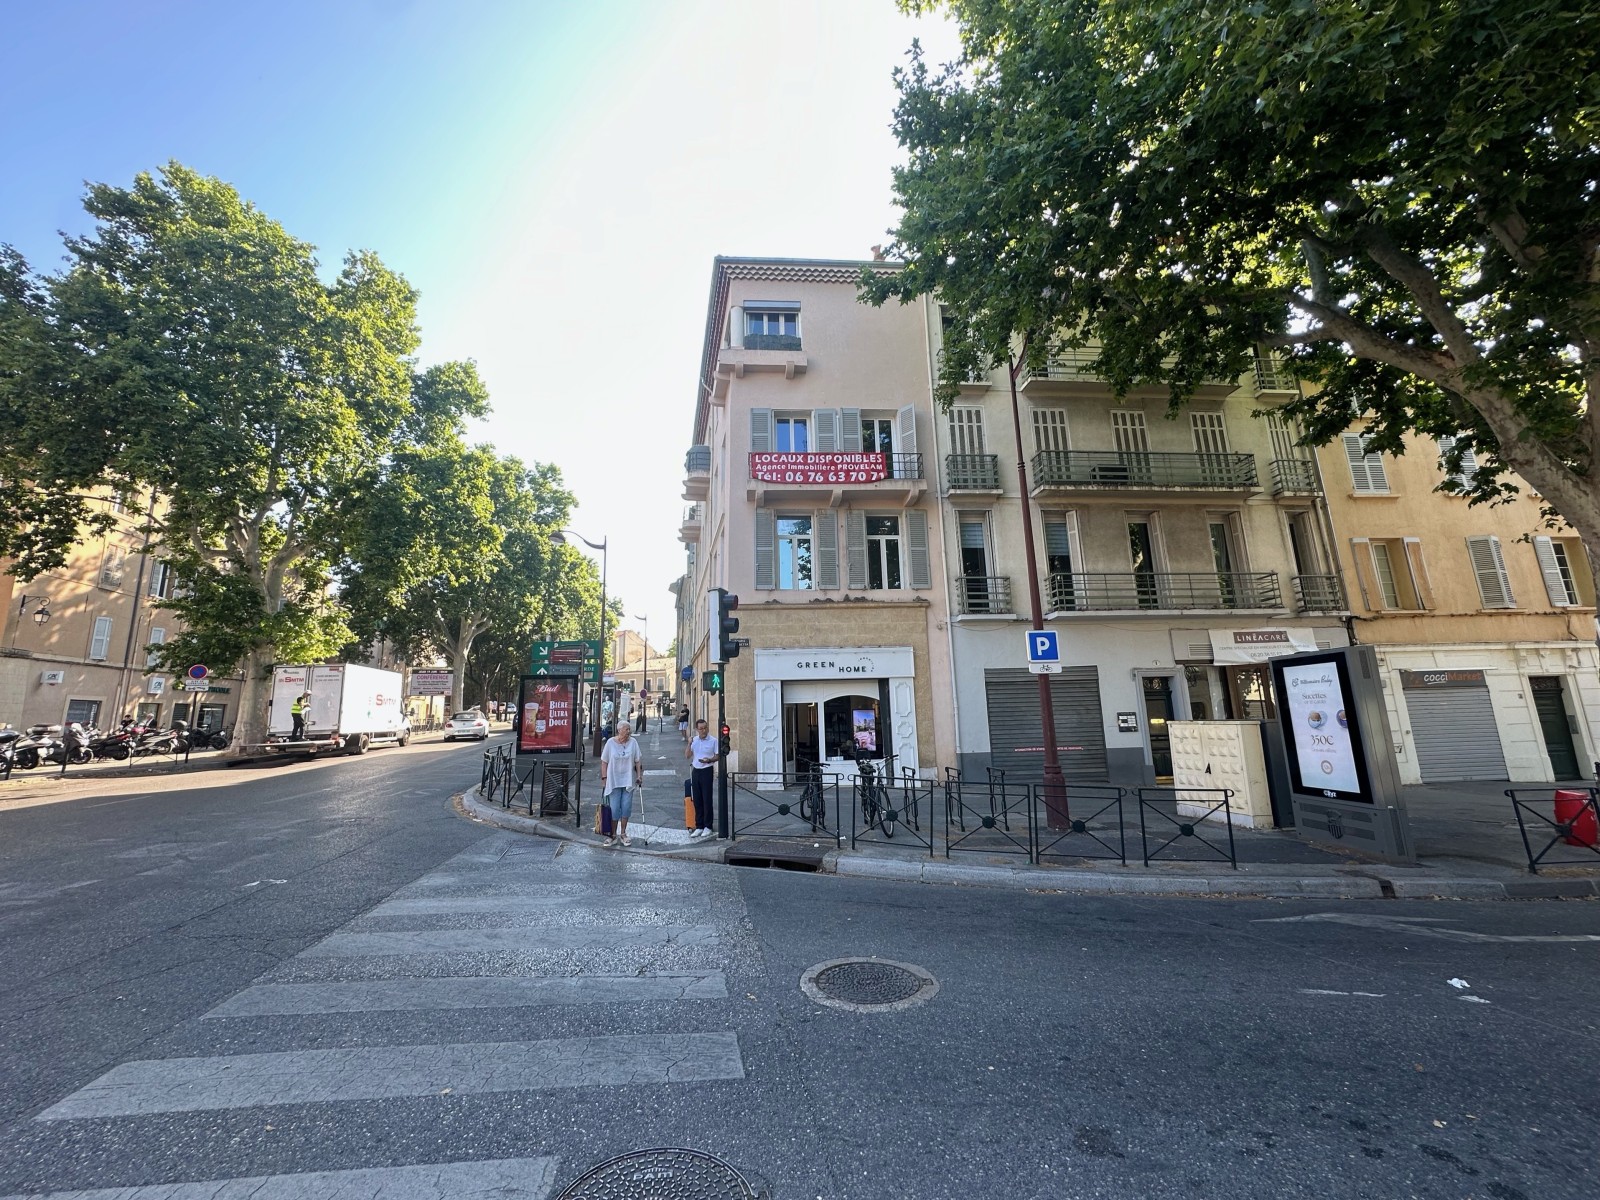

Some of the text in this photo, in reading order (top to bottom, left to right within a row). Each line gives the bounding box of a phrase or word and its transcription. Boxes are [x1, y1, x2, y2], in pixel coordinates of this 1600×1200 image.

[755, 454, 882, 463] LOCAUX DISPONIBLES
[755, 463, 786, 472] Agence
[756, 471, 885, 482] Tél: 06 76 63 70 71
[1036, 637, 1050, 656] P
[797, 661, 835, 669] GREEN
[536, 684, 559, 692] Bud
[549, 710, 568, 718] ULTRA
[548, 718, 568, 727] DOUCE
[1310, 734, 1335, 746] 350€
[633, 1168, 673, 1181] PAM
